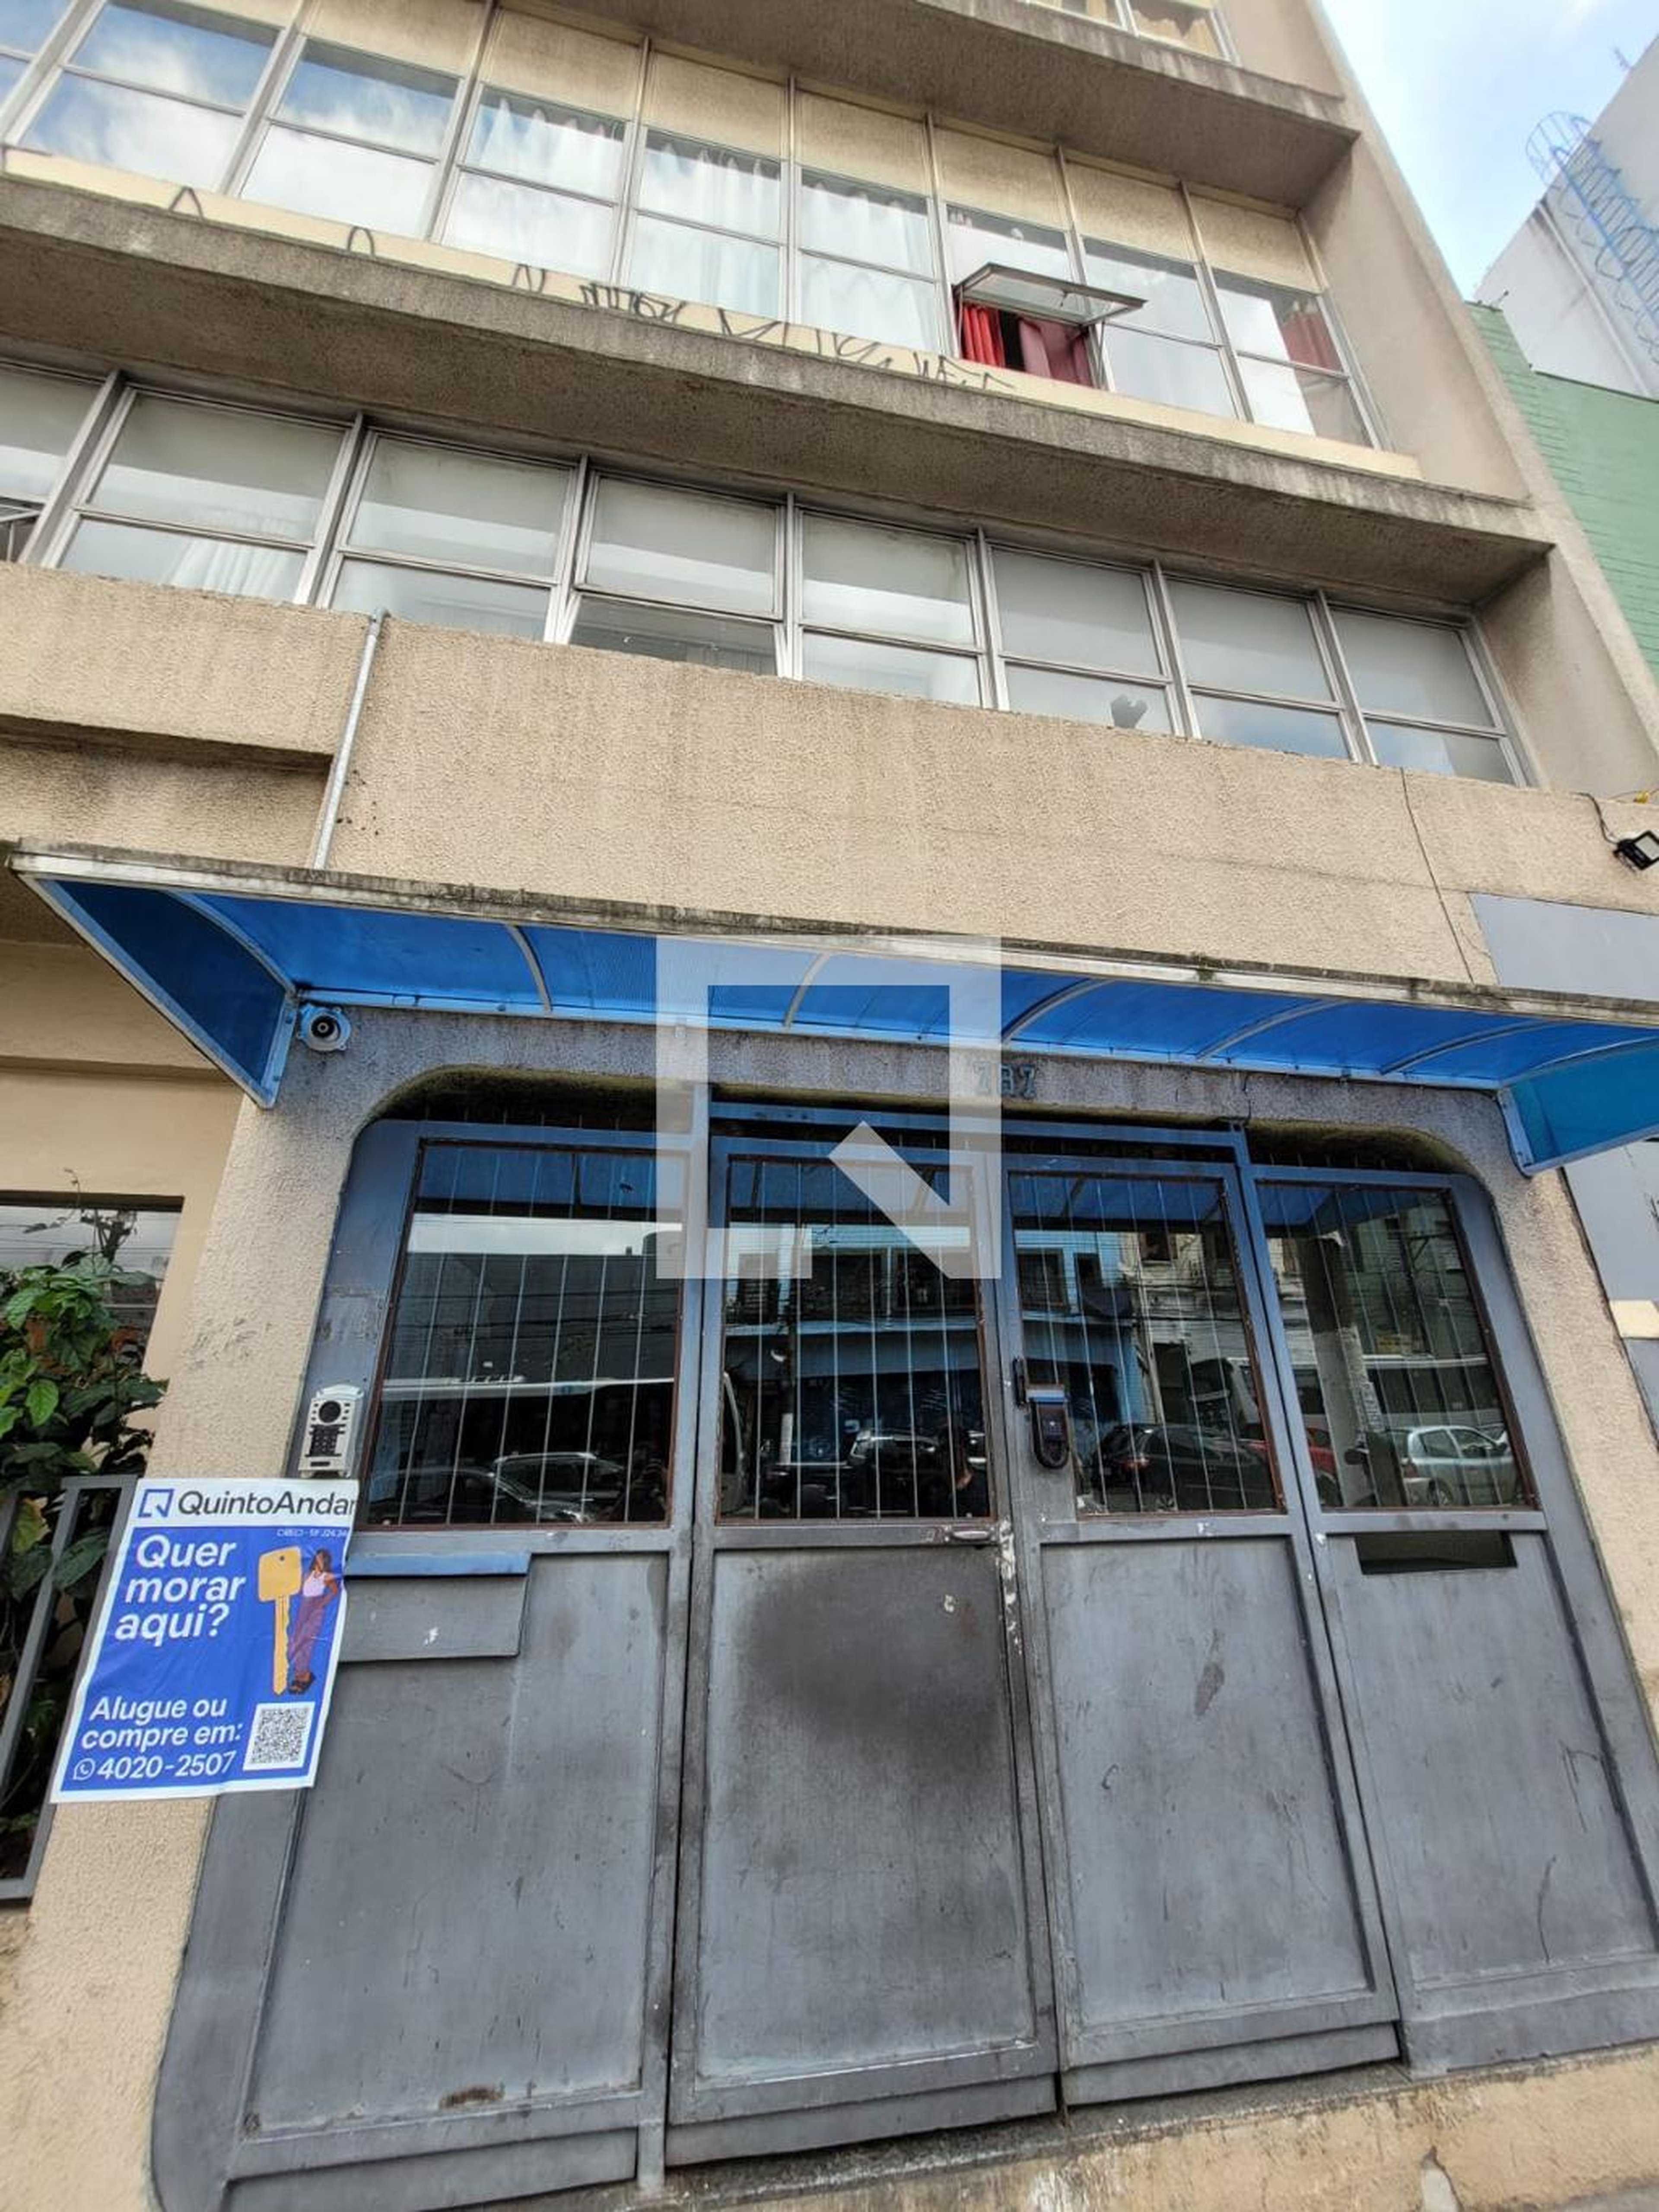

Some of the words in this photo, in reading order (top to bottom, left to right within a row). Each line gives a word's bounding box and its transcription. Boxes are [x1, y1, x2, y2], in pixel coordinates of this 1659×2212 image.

[178, 1491, 355, 1516] QuintoAndar
[137, 1534, 236, 1568] Quer
[124, 1575, 246, 1604] morar
[114, 1604, 230, 1647] aqui?
[89, 1696, 187, 1726] Alugue
[193, 1699, 227, 1718] ou
[82, 1729, 188, 1753] compre
[194, 1723, 242, 1745] em:
[97, 1751, 237, 1779] 4020-2507
